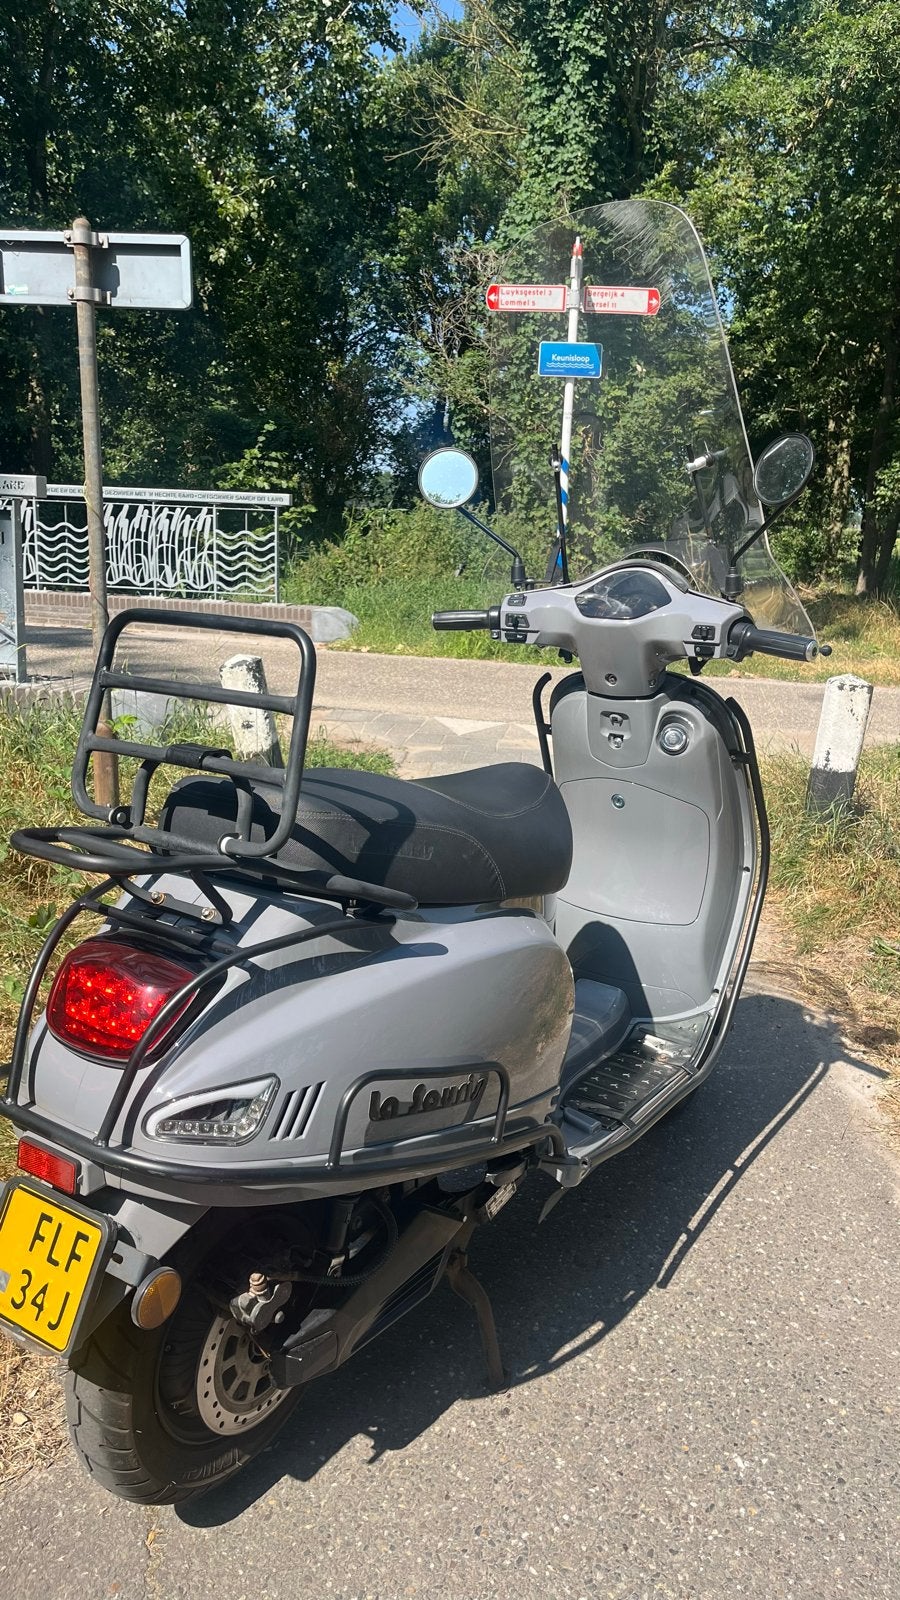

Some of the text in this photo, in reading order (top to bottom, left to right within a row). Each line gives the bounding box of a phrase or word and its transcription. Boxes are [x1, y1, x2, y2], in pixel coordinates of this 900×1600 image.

[500, 288, 546, 297] Luyksgestel
[587, 289, 618, 299] Bergeijk
[587, 300, 610, 308] Eersel
[551, 353, 590, 364] Keunisloop
[0, 480, 26, 490] AND
[29, 1211, 90, 1273] FLF
[10, 1268, 71, 1331] 34J
